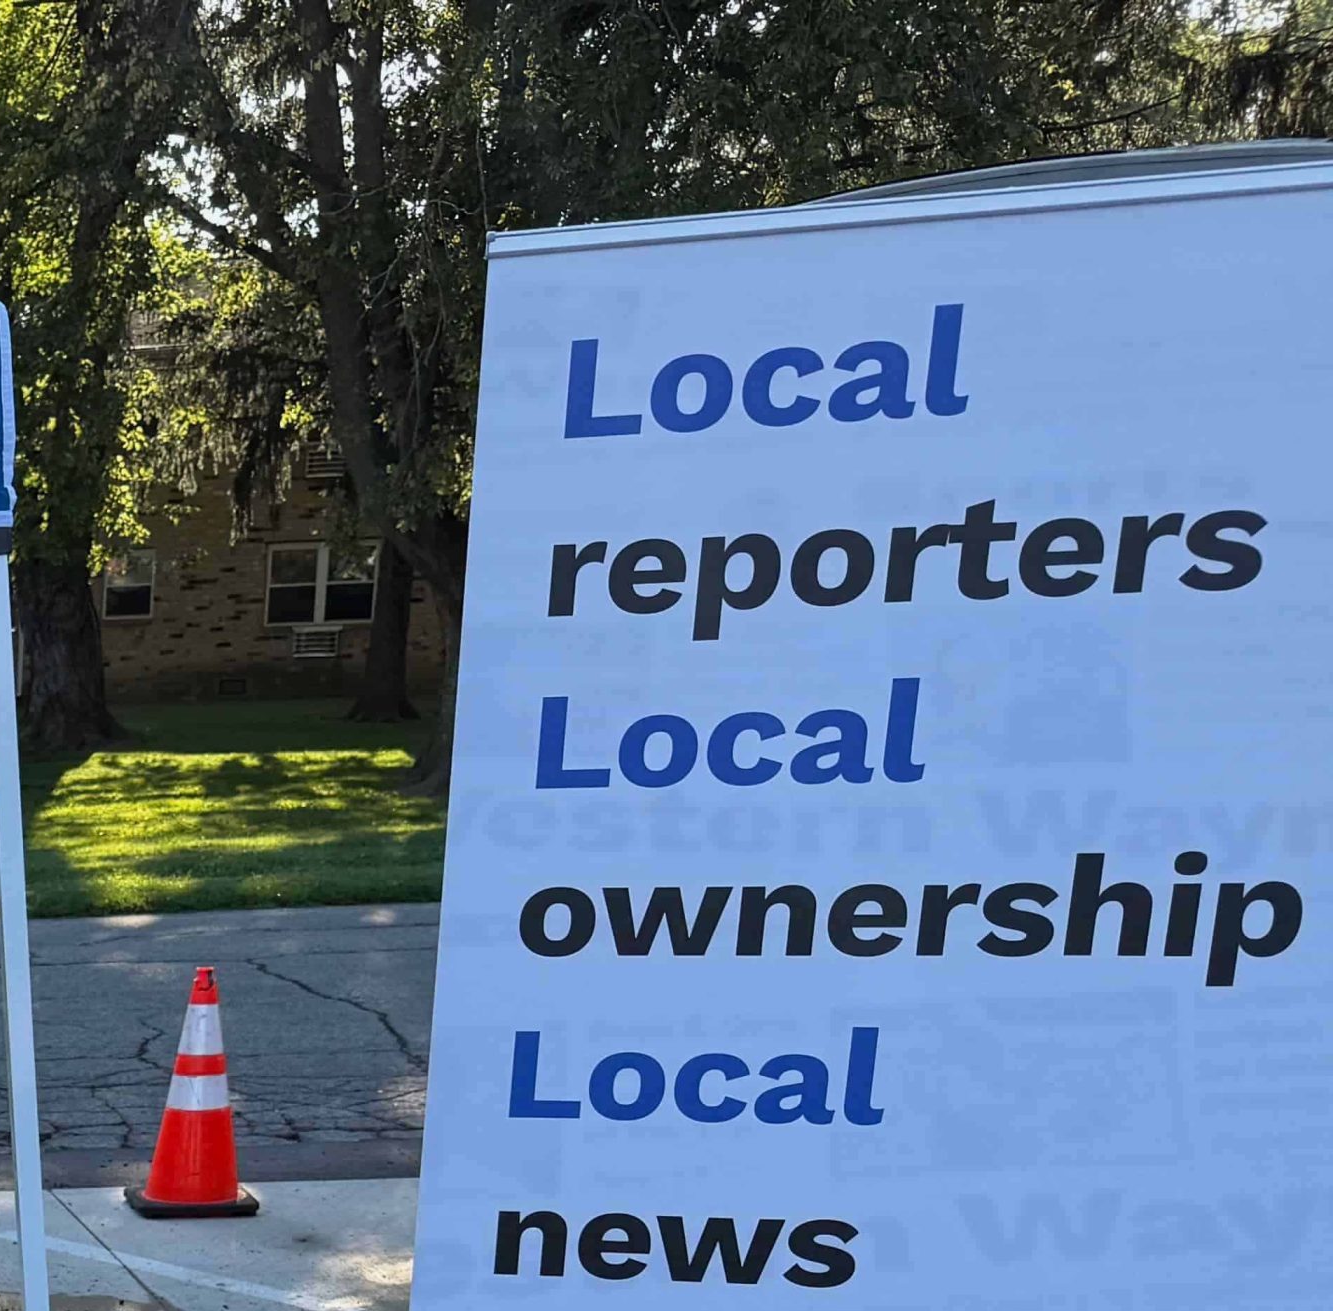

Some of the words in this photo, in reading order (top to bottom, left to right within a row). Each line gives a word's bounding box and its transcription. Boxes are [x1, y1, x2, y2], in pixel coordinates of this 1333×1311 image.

[563, 303, 970, 439] Local
[547, 498, 1269, 642] reporters
[535, 677, 926, 790] Local
[519, 850, 1303, 987] ownership
[508, 1026, 885, 1126] Local
[493, 1210, 859, 1289] news
